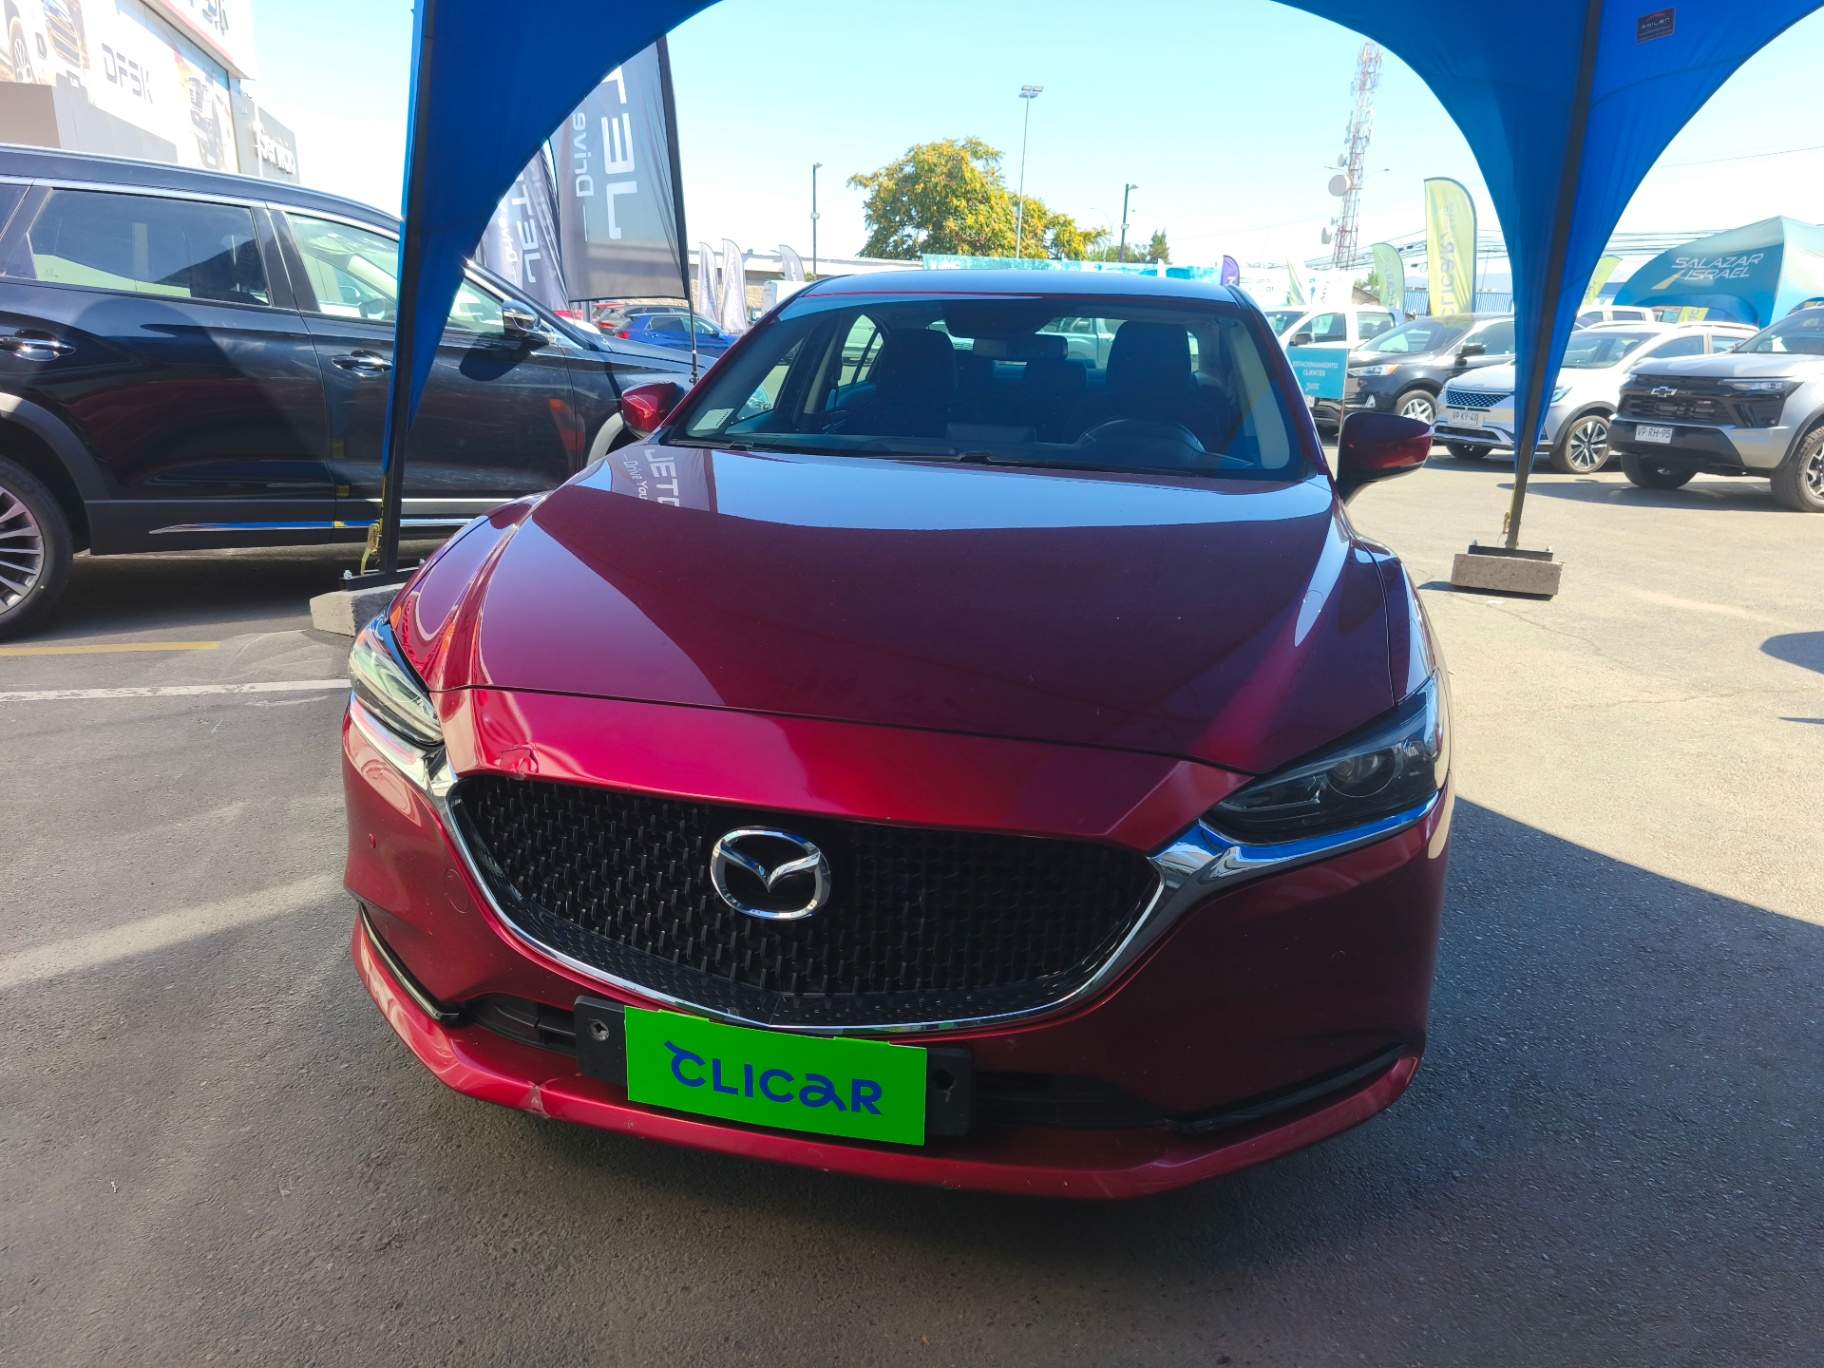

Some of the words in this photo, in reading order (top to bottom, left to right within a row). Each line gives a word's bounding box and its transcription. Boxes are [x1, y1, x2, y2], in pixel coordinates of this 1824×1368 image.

[102, 42, 152, 104] DFSK
[1672, 253, 1764, 269] SALAZAR
[1684, 266, 1750, 281] ISRAEL
